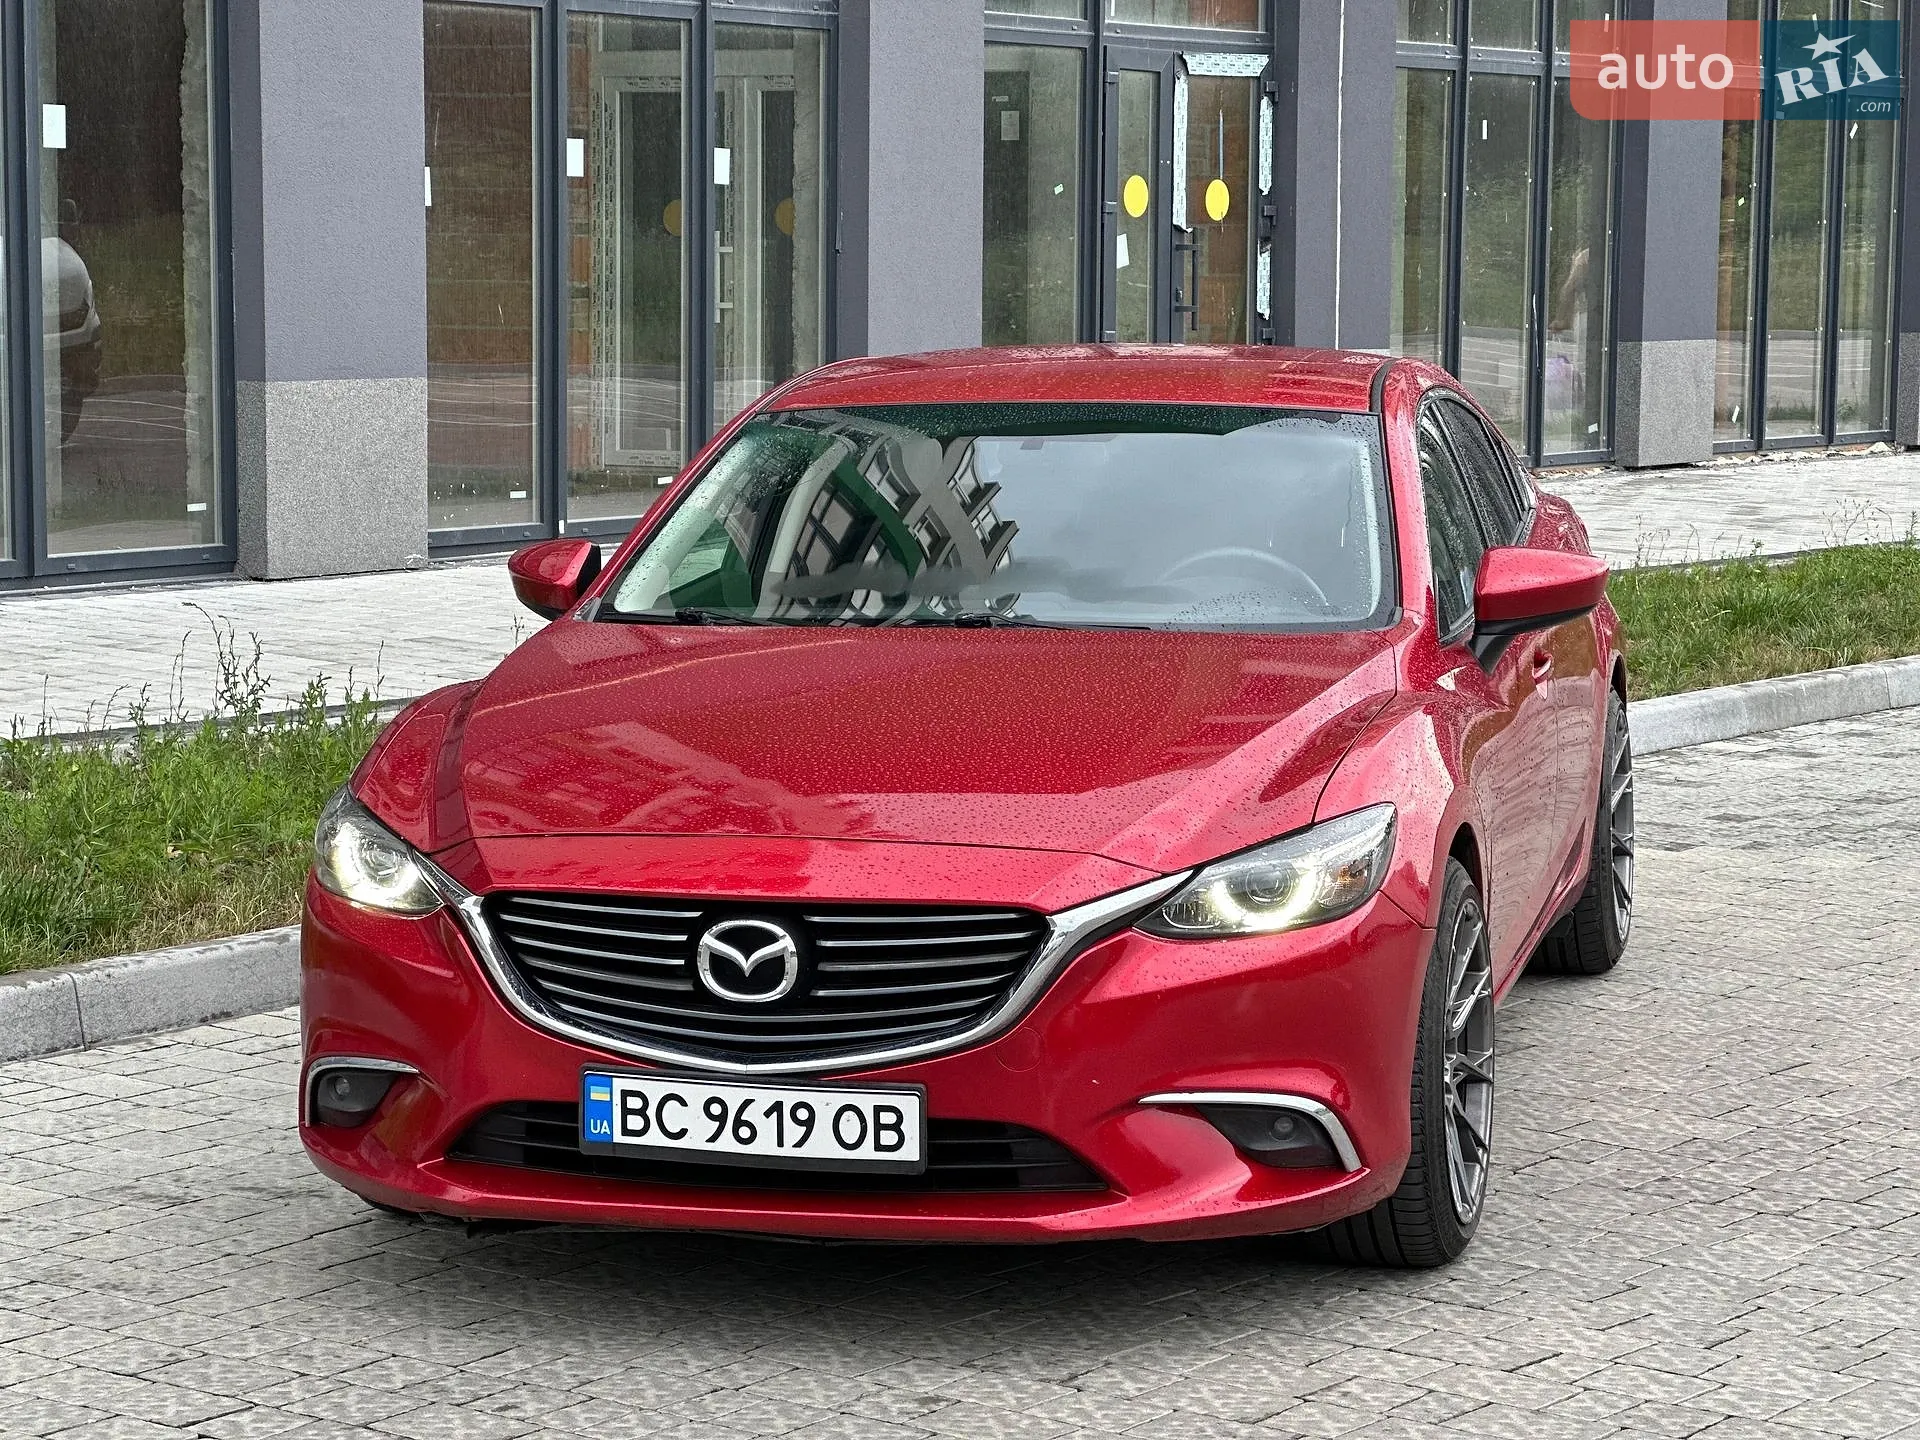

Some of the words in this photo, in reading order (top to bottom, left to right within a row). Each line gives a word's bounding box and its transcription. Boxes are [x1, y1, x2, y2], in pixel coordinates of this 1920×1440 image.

[590, 1118, 611, 1135] UA
[619, 1088, 689, 1141] BC
[702, 1096, 816, 1148] 9619
[831, 1103, 906, 1153] OB
